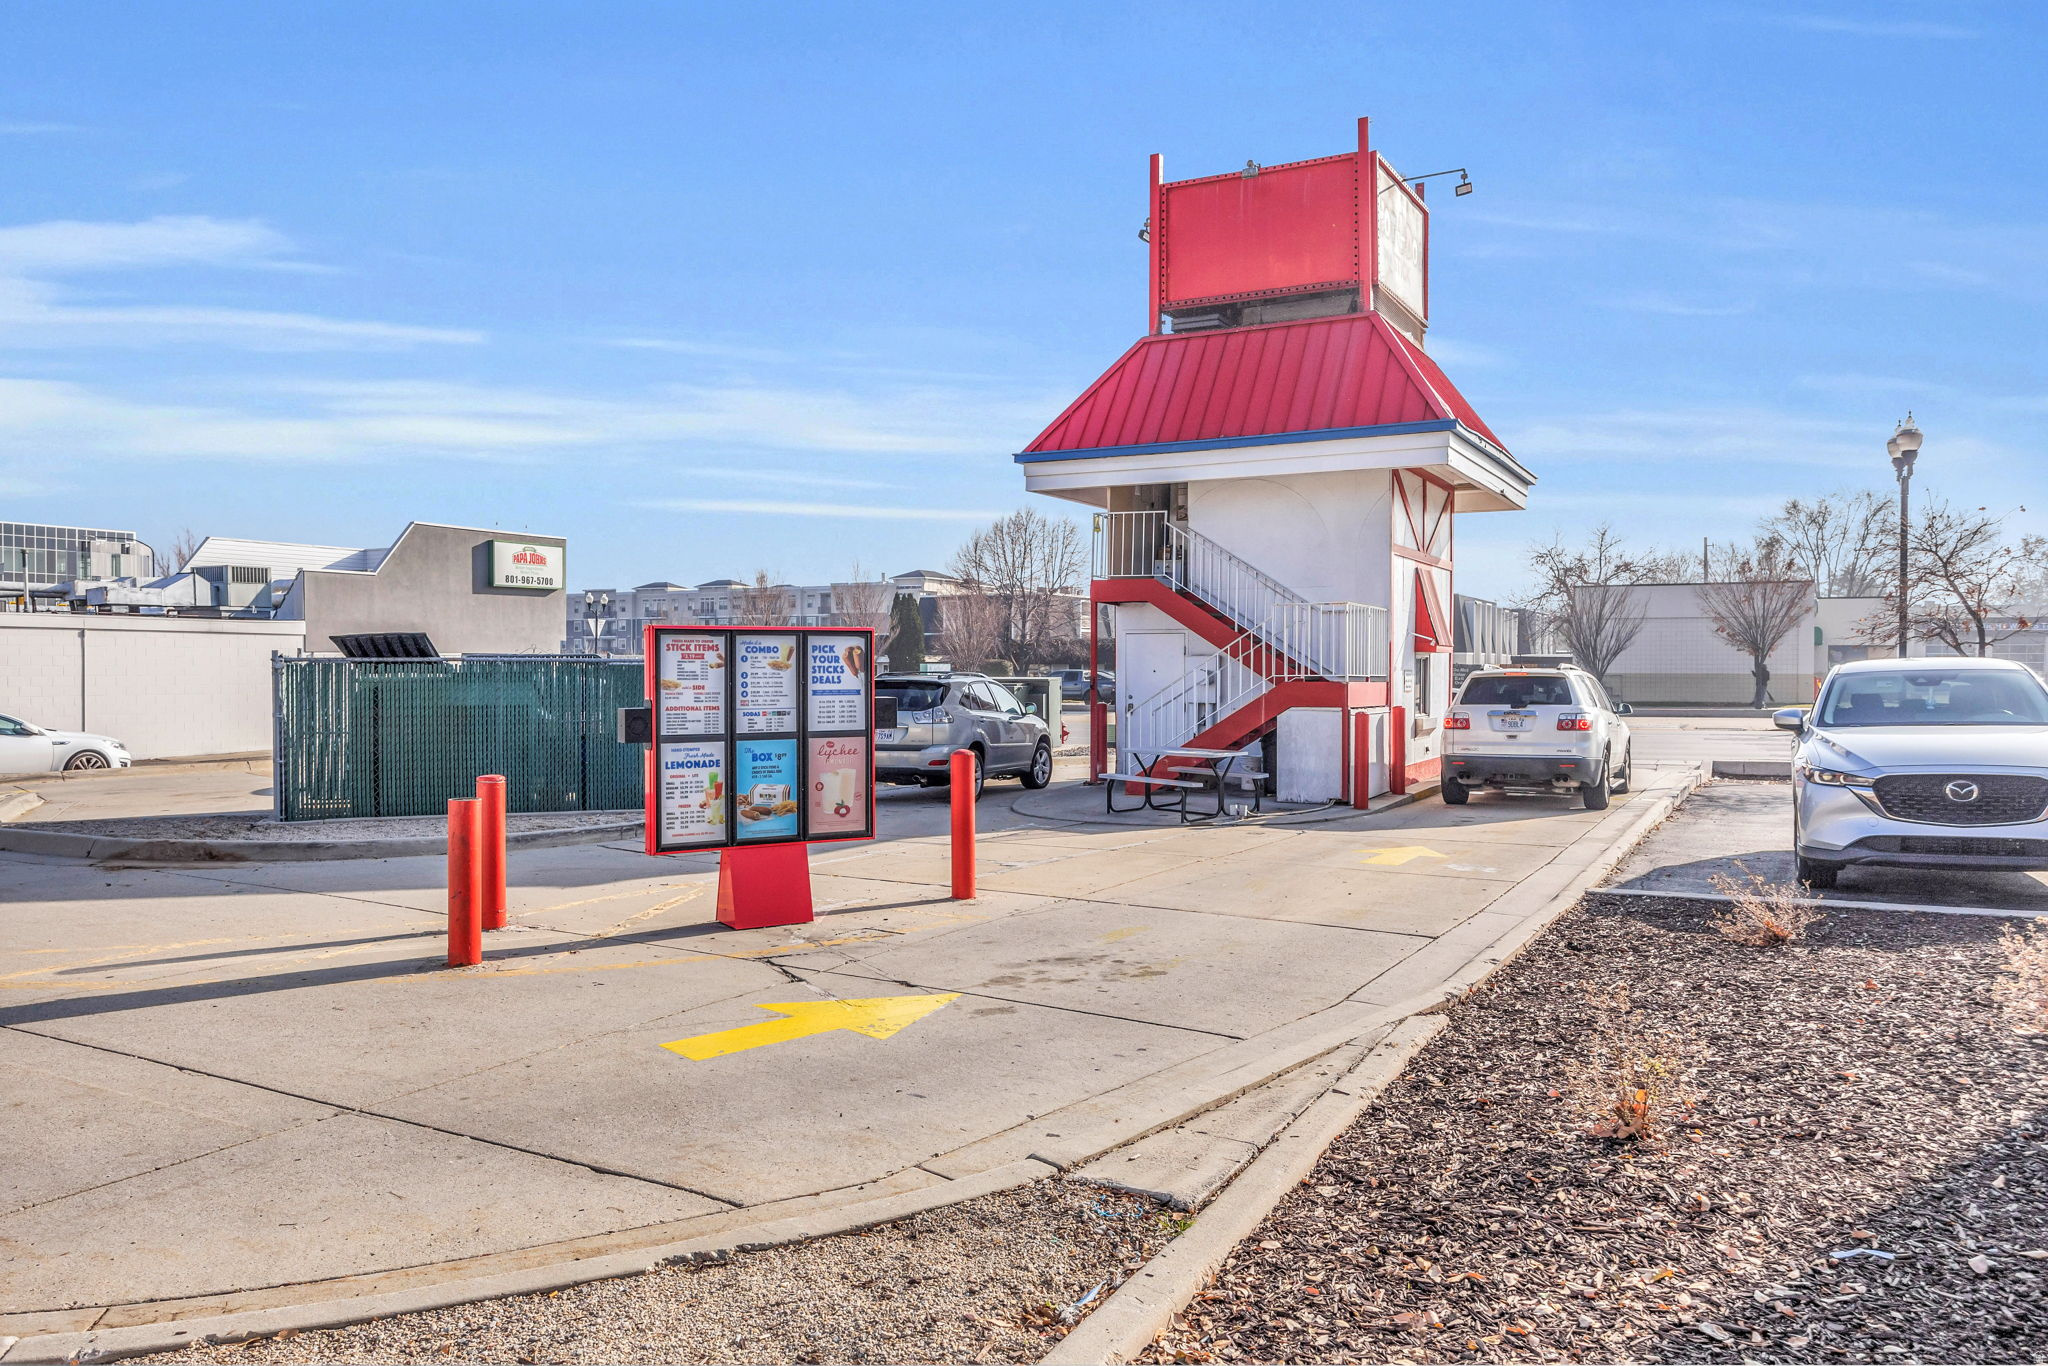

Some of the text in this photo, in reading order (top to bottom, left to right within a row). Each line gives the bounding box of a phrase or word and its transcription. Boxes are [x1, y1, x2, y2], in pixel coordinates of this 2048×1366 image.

[513, 553, 527, 563] PAPA
[505, 575, 554, 585] 801-967-5700
[812, 645, 835, 653] PICK
[812, 666, 845, 674] STICKS
[812, 676, 842, 684] DEALS
[752, 753, 773, 762] BOX
[817, 744, 859, 763] lychee
[665, 760, 720, 770] LEMONADE
